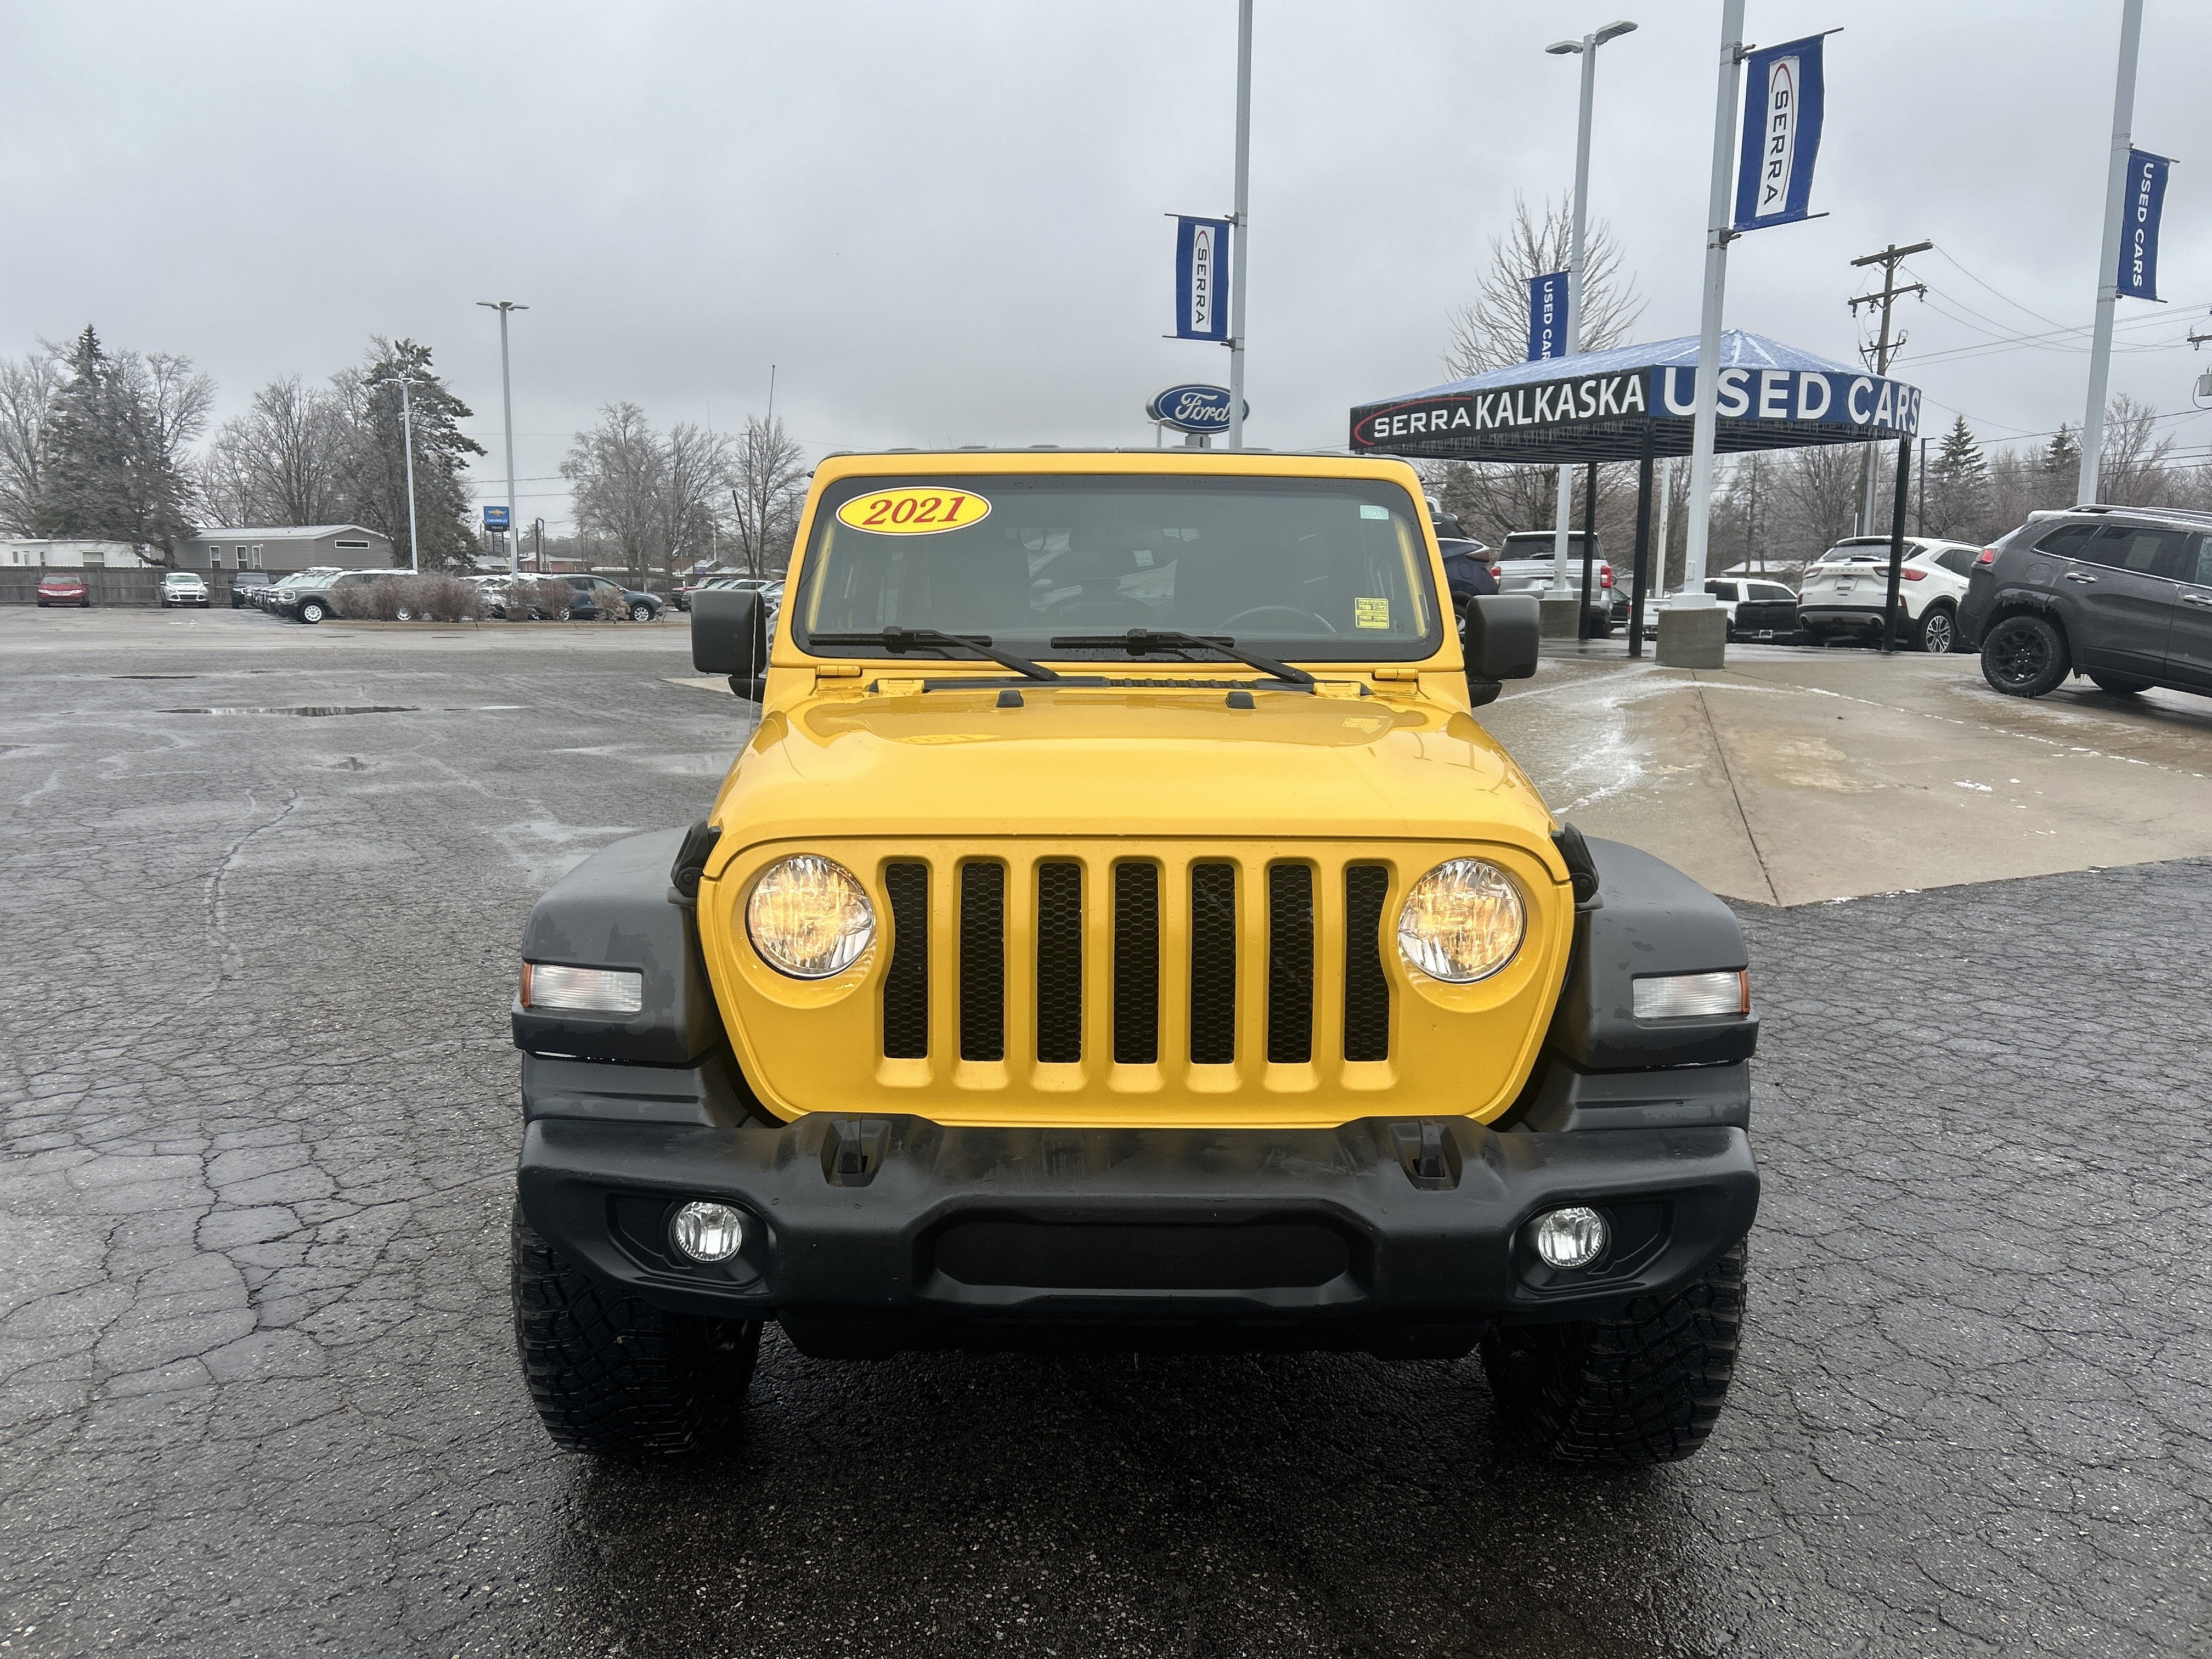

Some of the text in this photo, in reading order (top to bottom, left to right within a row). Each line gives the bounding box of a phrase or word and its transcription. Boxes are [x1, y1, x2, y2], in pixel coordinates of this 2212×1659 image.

[1764, 89, 1788, 205] SERRA
[2132, 162, 2154, 287] USED CARS
[1195, 247, 1207, 324] SERRA
[1543, 280, 1553, 325] USED
[1175, 392, 1231, 422] Ford
[1374, 374, 1645, 438] SERRA KALKASKA
[1663, 366, 1920, 435] USED CARS
[862, 496, 966, 525] 2021
